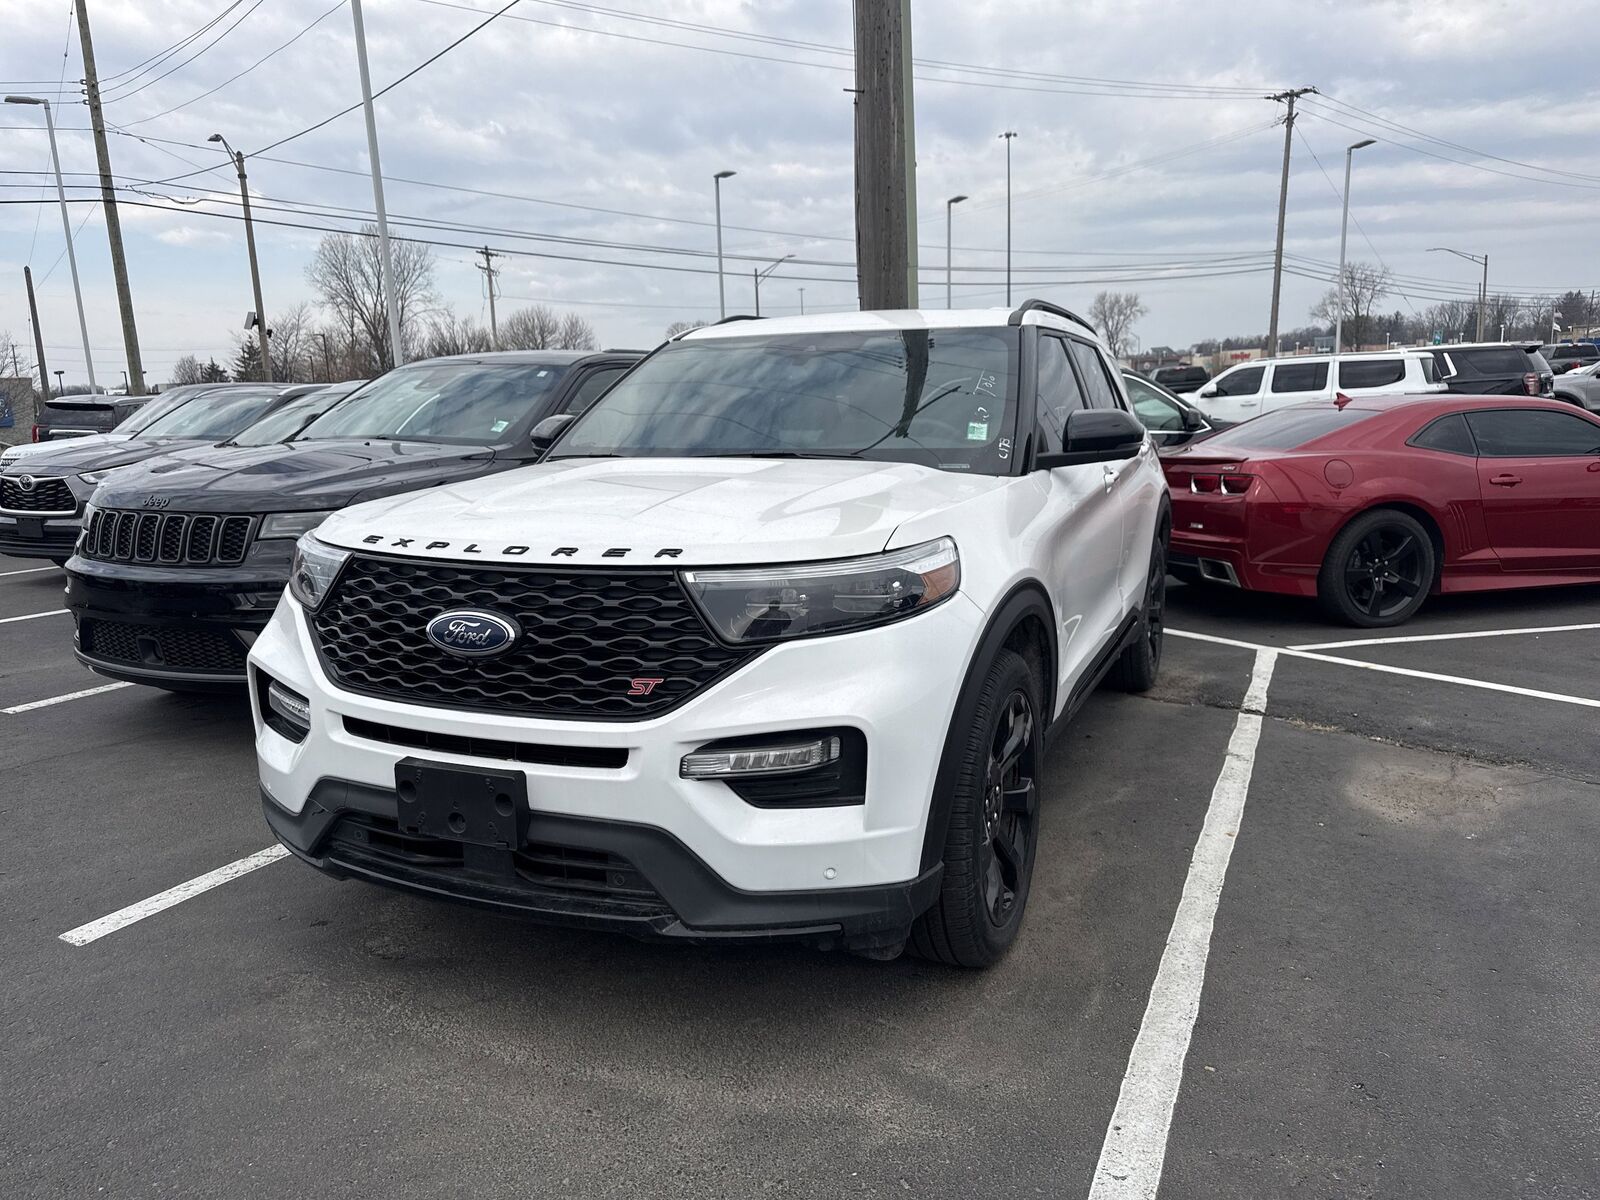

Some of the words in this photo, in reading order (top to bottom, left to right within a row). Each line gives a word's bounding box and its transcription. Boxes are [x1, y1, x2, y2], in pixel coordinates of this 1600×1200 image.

[143, 494, 170, 509] Jeep
[363, 534, 684, 558] EXPLORER
[442, 619, 491, 647] Ford
[627, 677, 664, 696] ST
